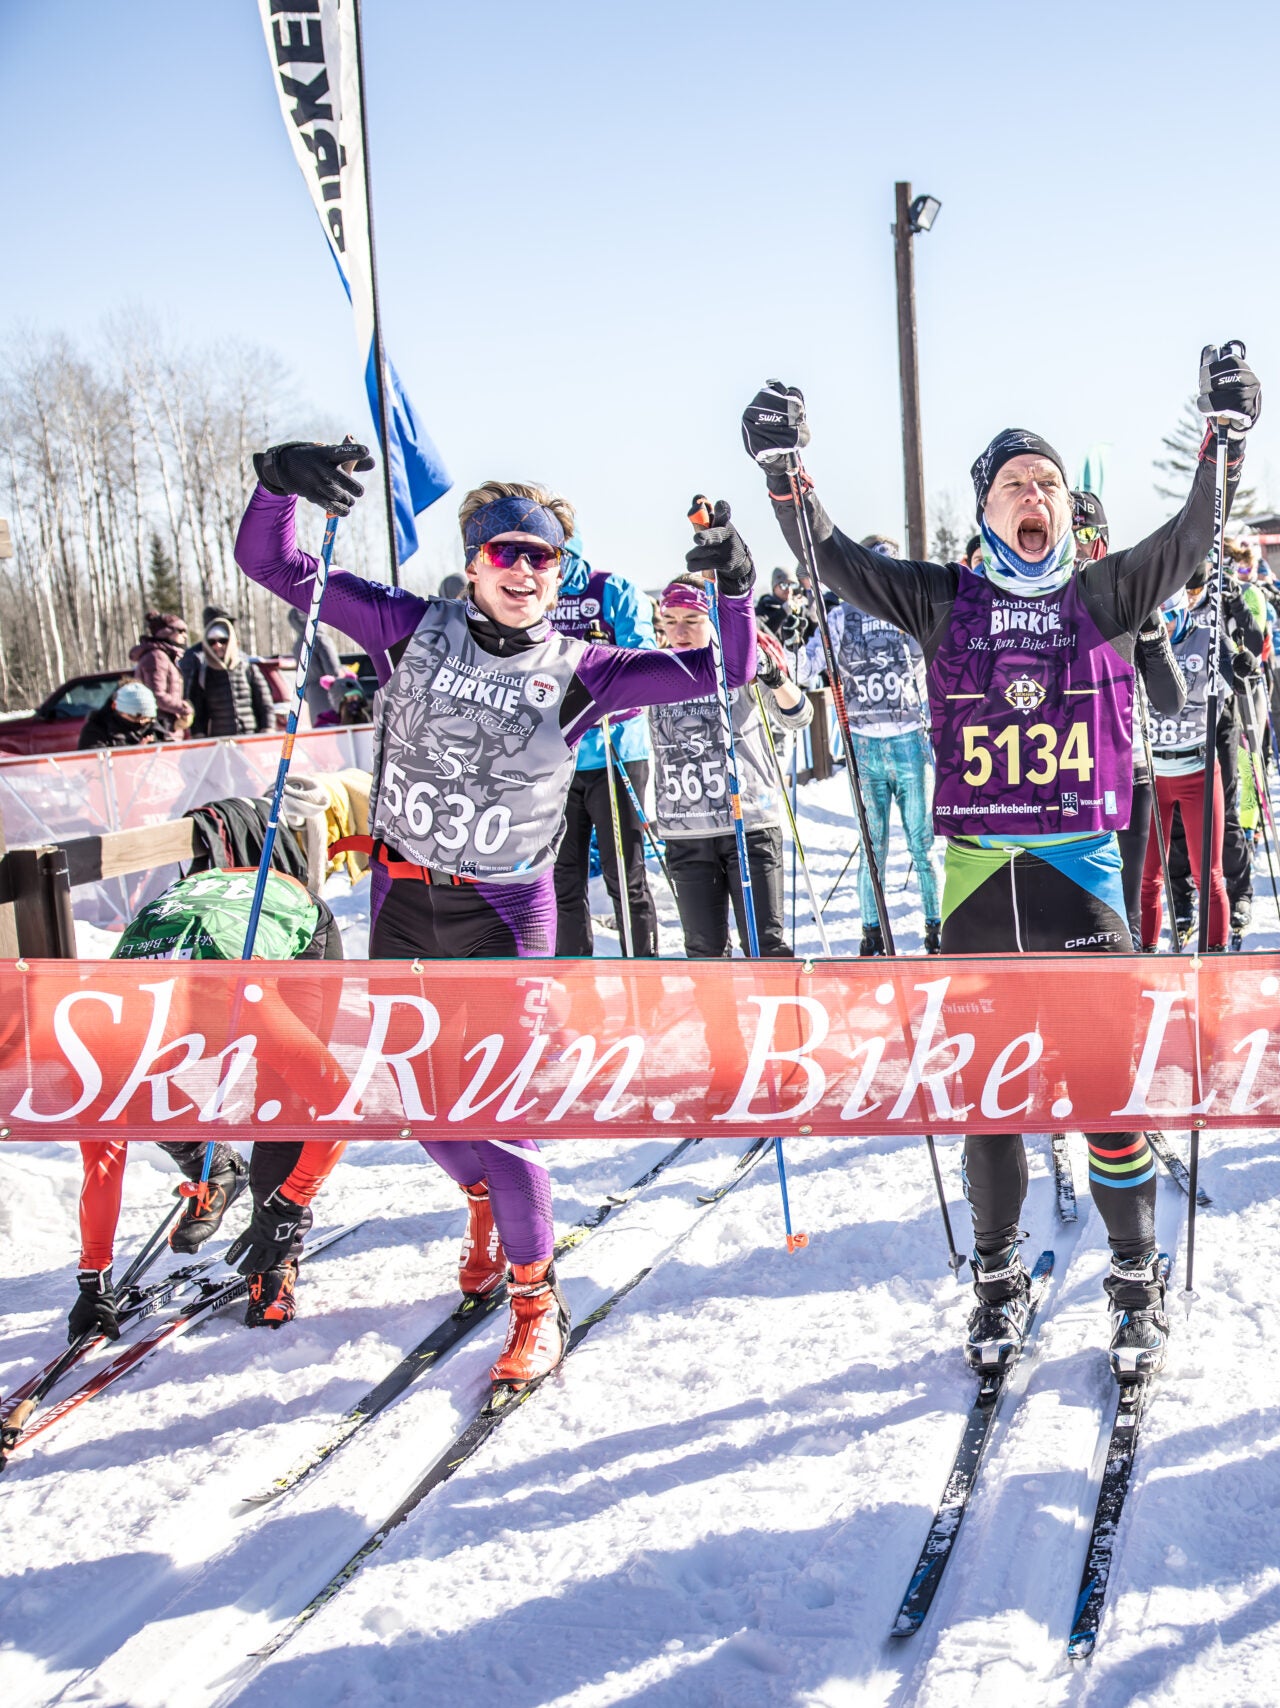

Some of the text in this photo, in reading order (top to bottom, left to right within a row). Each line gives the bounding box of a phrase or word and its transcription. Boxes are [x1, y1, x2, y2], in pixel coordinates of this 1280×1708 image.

[543, 606, 580, 620] RKIE
[584, 606, 595, 615] 29
[862, 619, 901, 635] BIRKI
[990, 608, 1061, 635] BIRKIE
[968, 634, 1077, 651] Ski. Run. Bike. Liv!
[445, 655, 526, 688] slumberland
[431, 666, 521, 714] BIRKIE
[533, 679, 556, 692] BIRKIE
[535, 688, 546, 703] 3
[408, 685, 535, 738] Ski. Run. Bike. Live!
[690, 707, 710, 716] Bike.
[962, 721, 1094, 787] 5134
[1062, 792, 1078, 801] US
[383, 762, 513, 854] 5630
[935, 803, 1042, 816] 2022 American Birkebeiner
[1064, 933, 1112, 949] CRAFT
[11, 978, 283, 1124] Ski.
[316, 993, 677, 1124] Run.
[713, 976, 1075, 1122] Bike.
[138, 1292, 173, 1321] MADSHUS
[211, 1284, 249, 1313] MADSHUS
